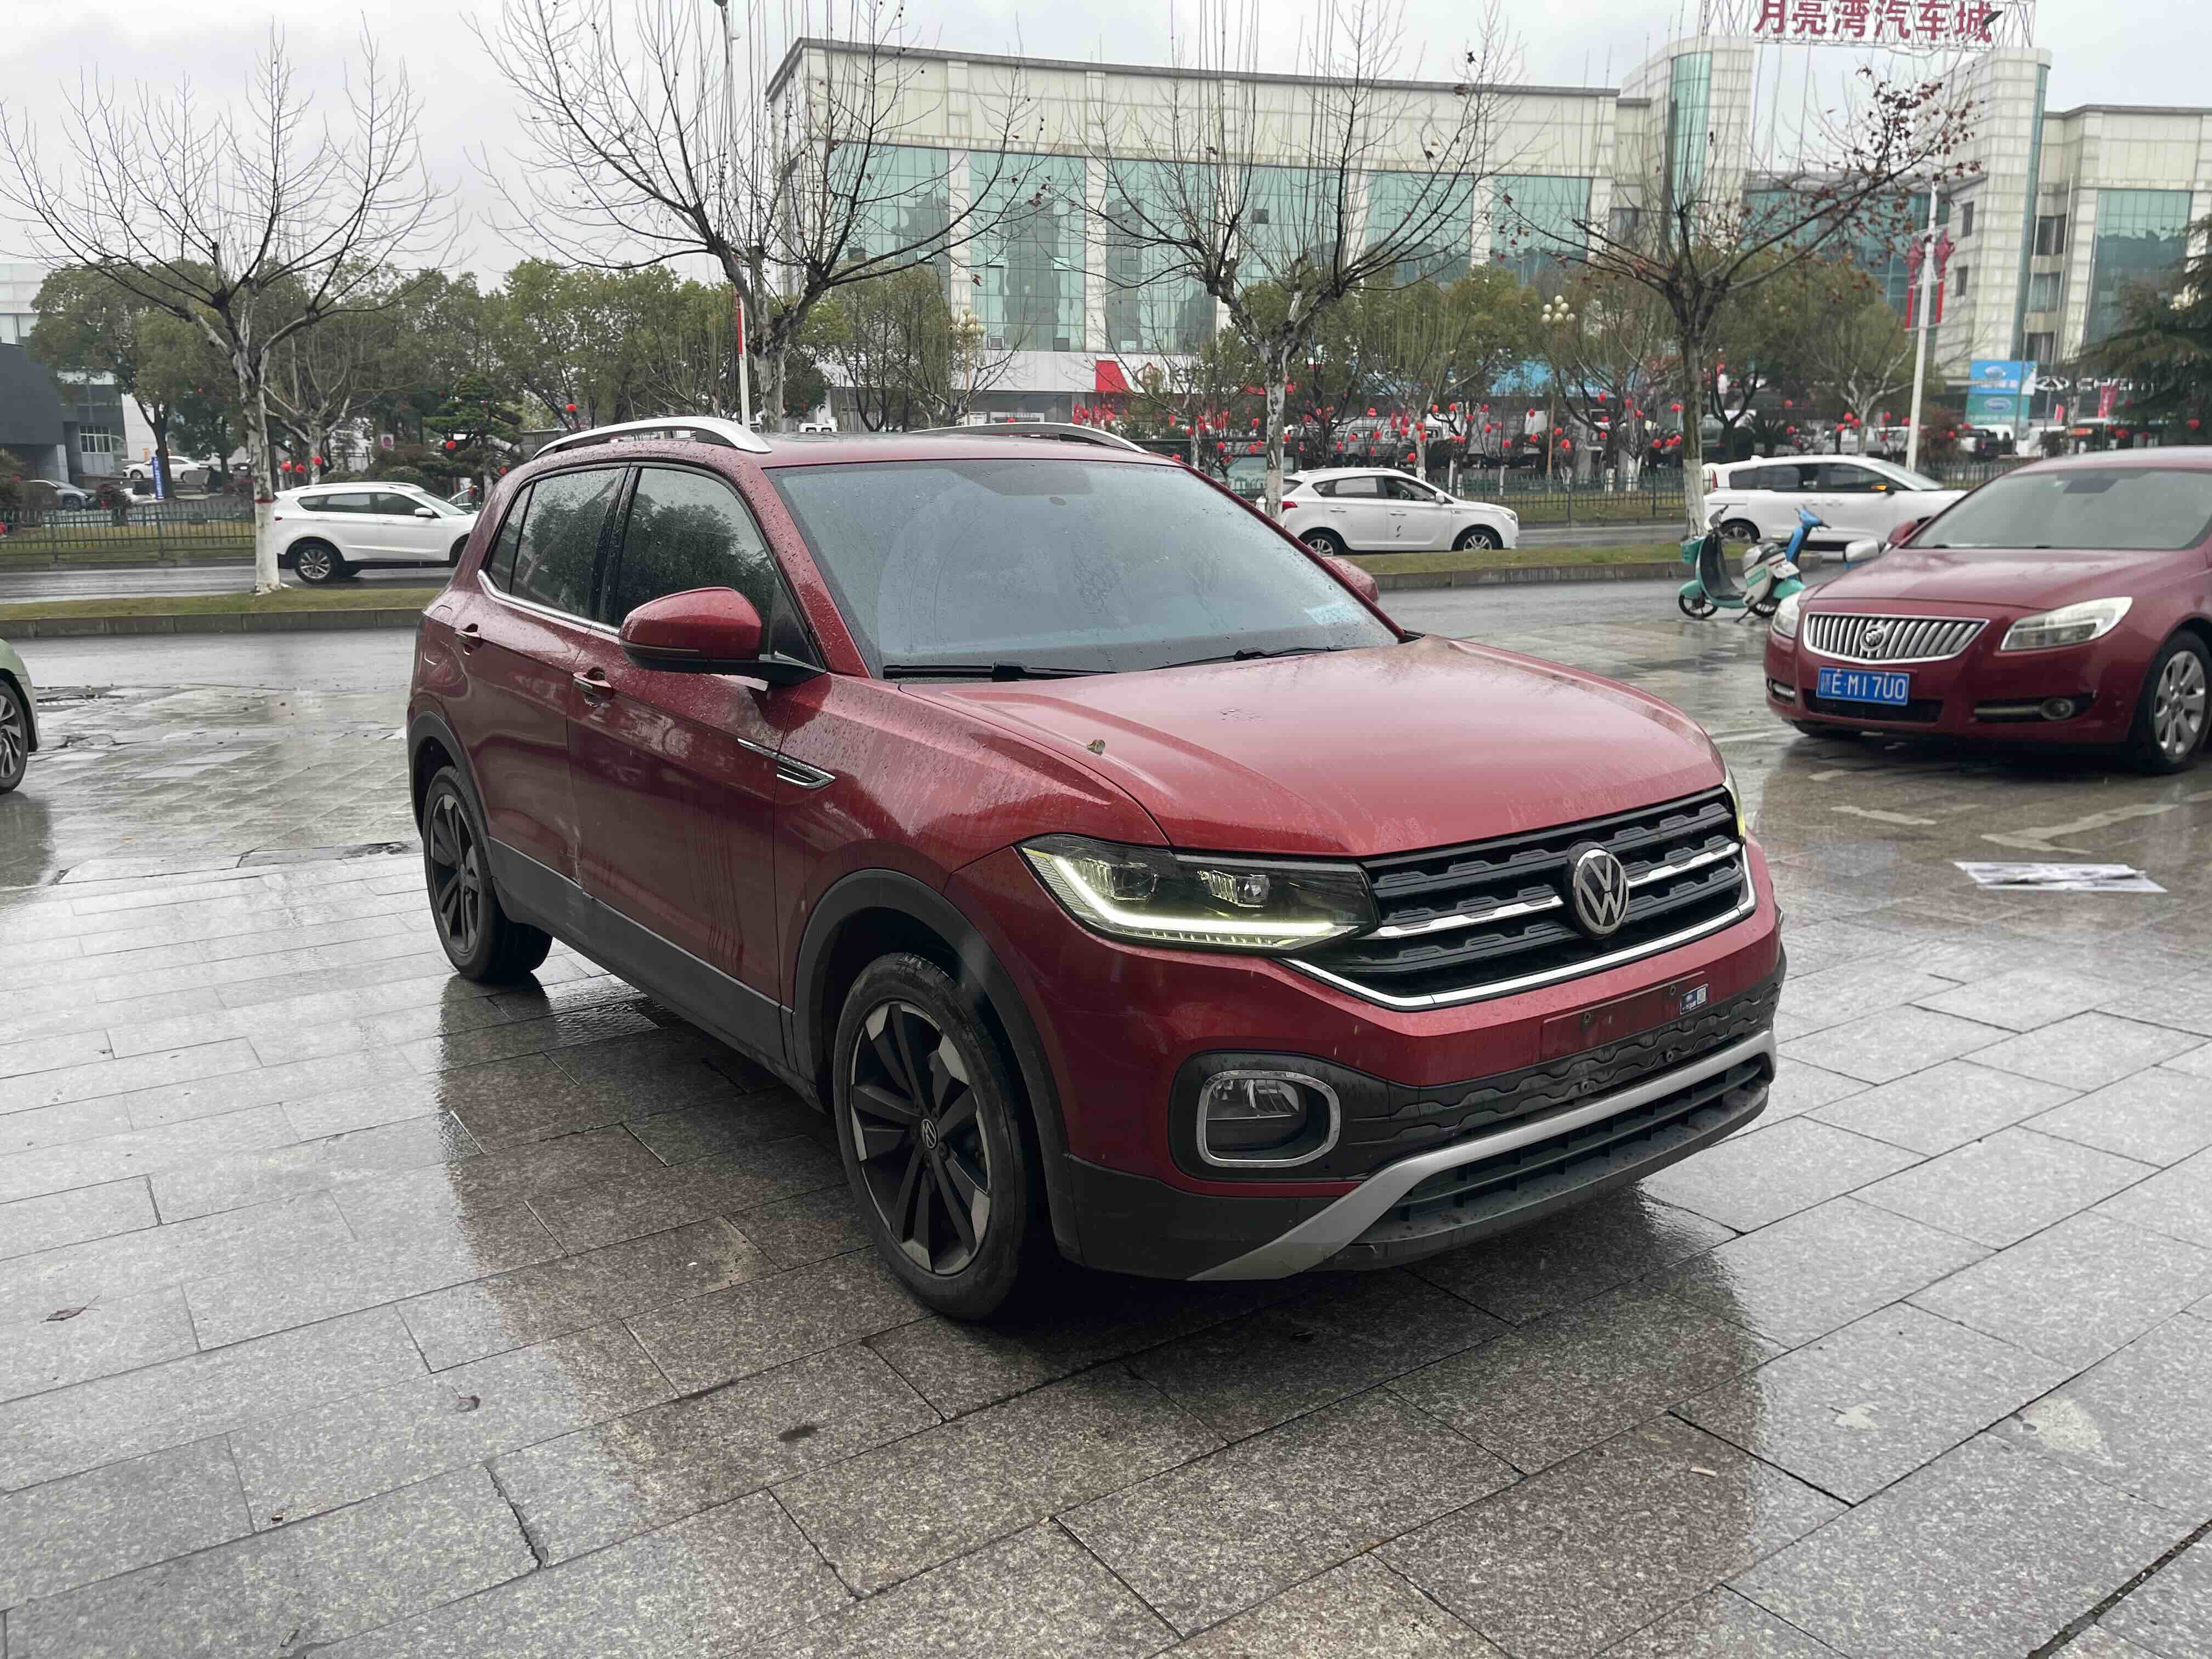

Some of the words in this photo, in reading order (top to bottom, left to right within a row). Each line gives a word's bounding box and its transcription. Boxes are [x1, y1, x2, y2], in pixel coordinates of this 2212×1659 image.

[1753, 0, 1993, 42] 月亮湾汽车城
